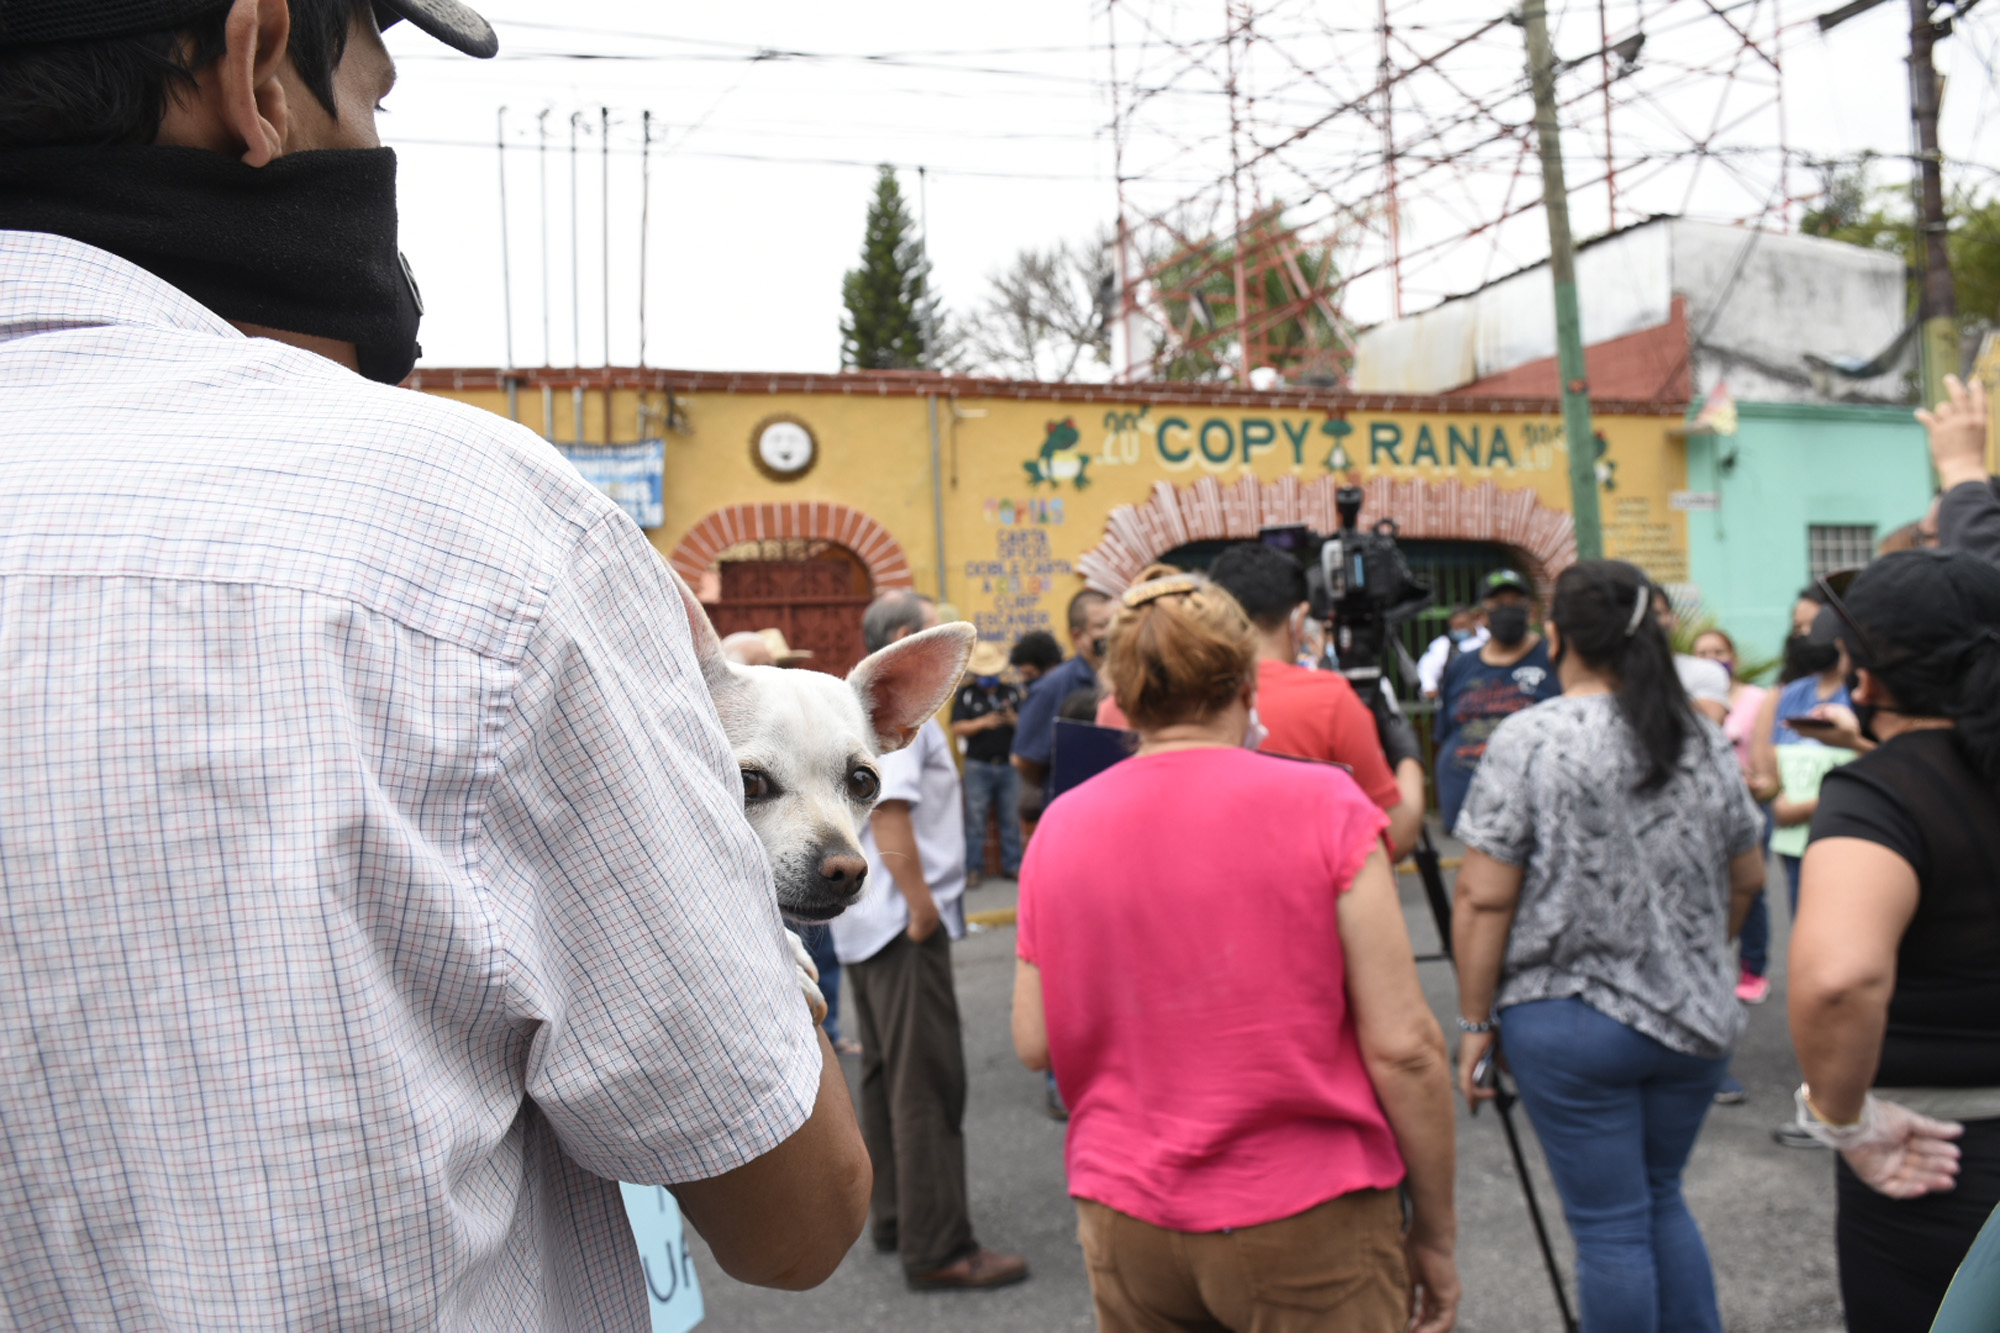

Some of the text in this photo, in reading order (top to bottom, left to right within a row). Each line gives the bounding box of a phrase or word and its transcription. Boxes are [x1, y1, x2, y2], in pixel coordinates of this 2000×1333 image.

[1156, 416, 1313, 470] COPY
[1369, 421, 1515, 470] RANA
[983, 497, 1066, 526] COPIAS
[997, 529, 1047, 545] CARTA
[965, 559, 1072, 577] DOBLE CARTA
